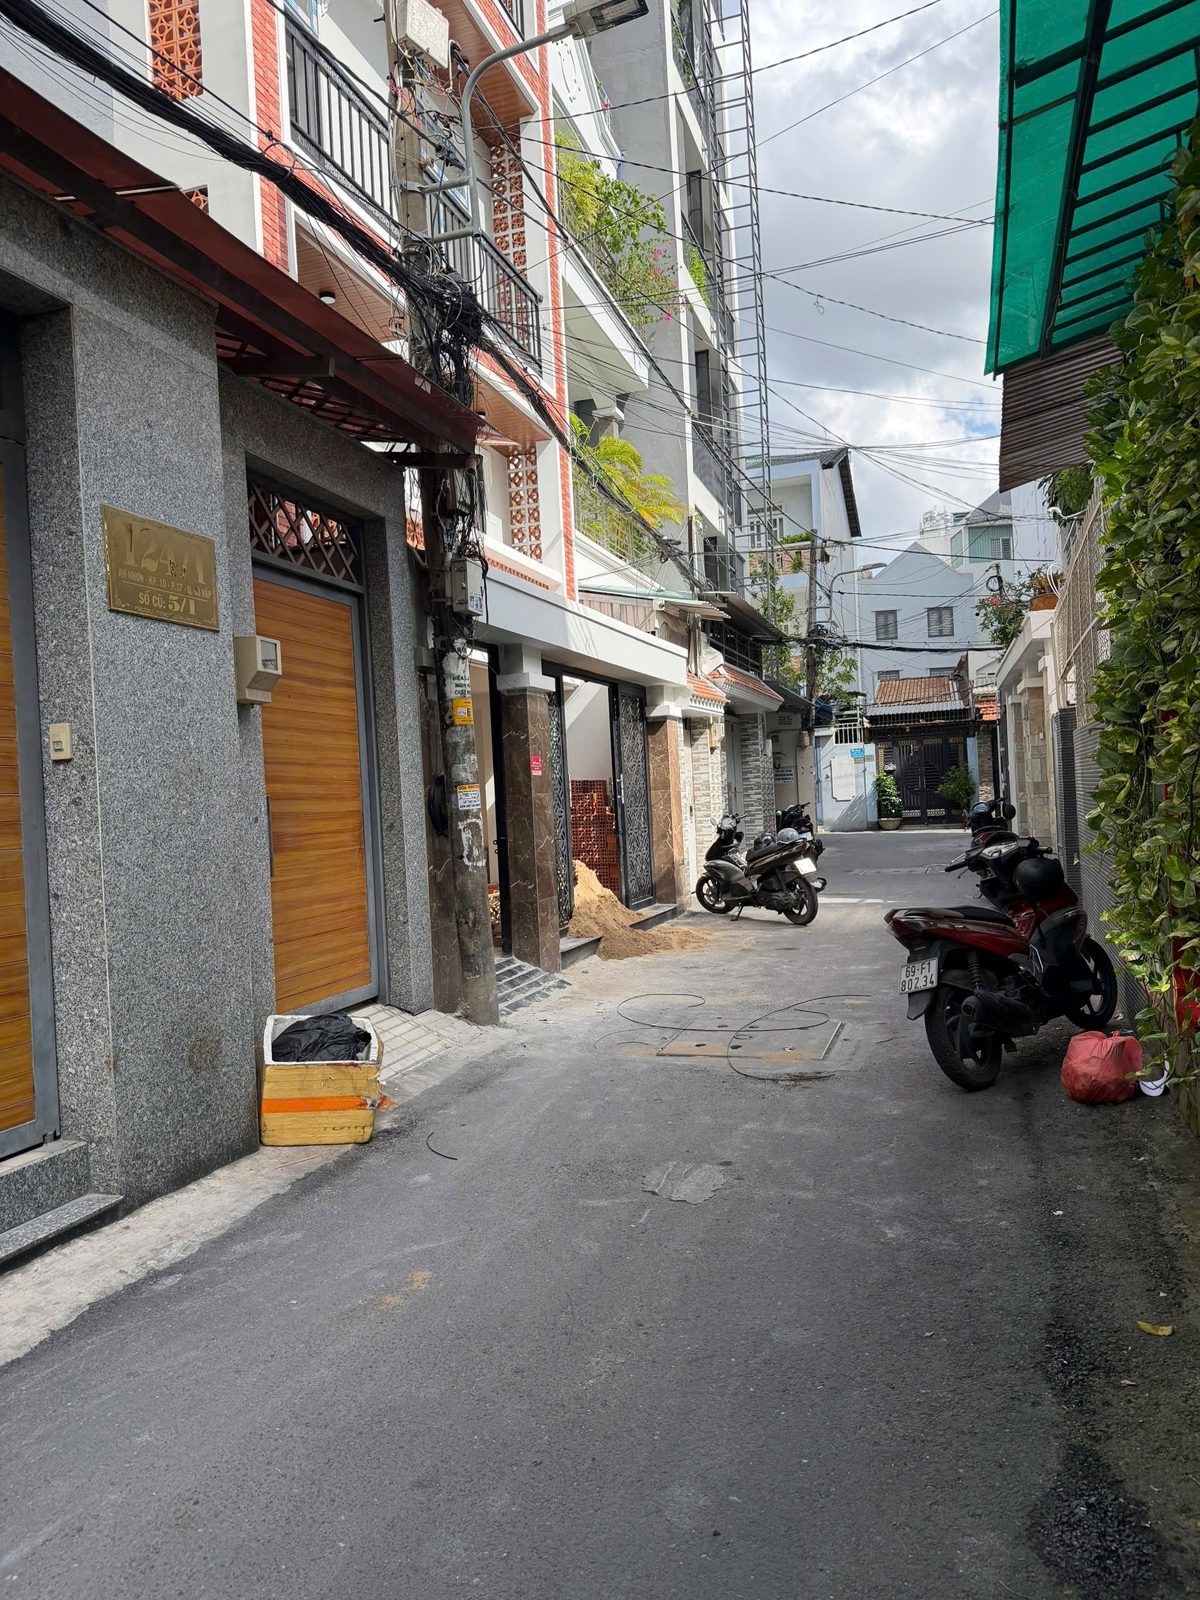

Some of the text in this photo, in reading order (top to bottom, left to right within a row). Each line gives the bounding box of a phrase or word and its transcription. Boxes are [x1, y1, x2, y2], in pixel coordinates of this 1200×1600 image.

[139, 589, 150, 606] SỐ
[168, 594, 197, 615] 5/1
[901, 973, 935, 992] 802.34
